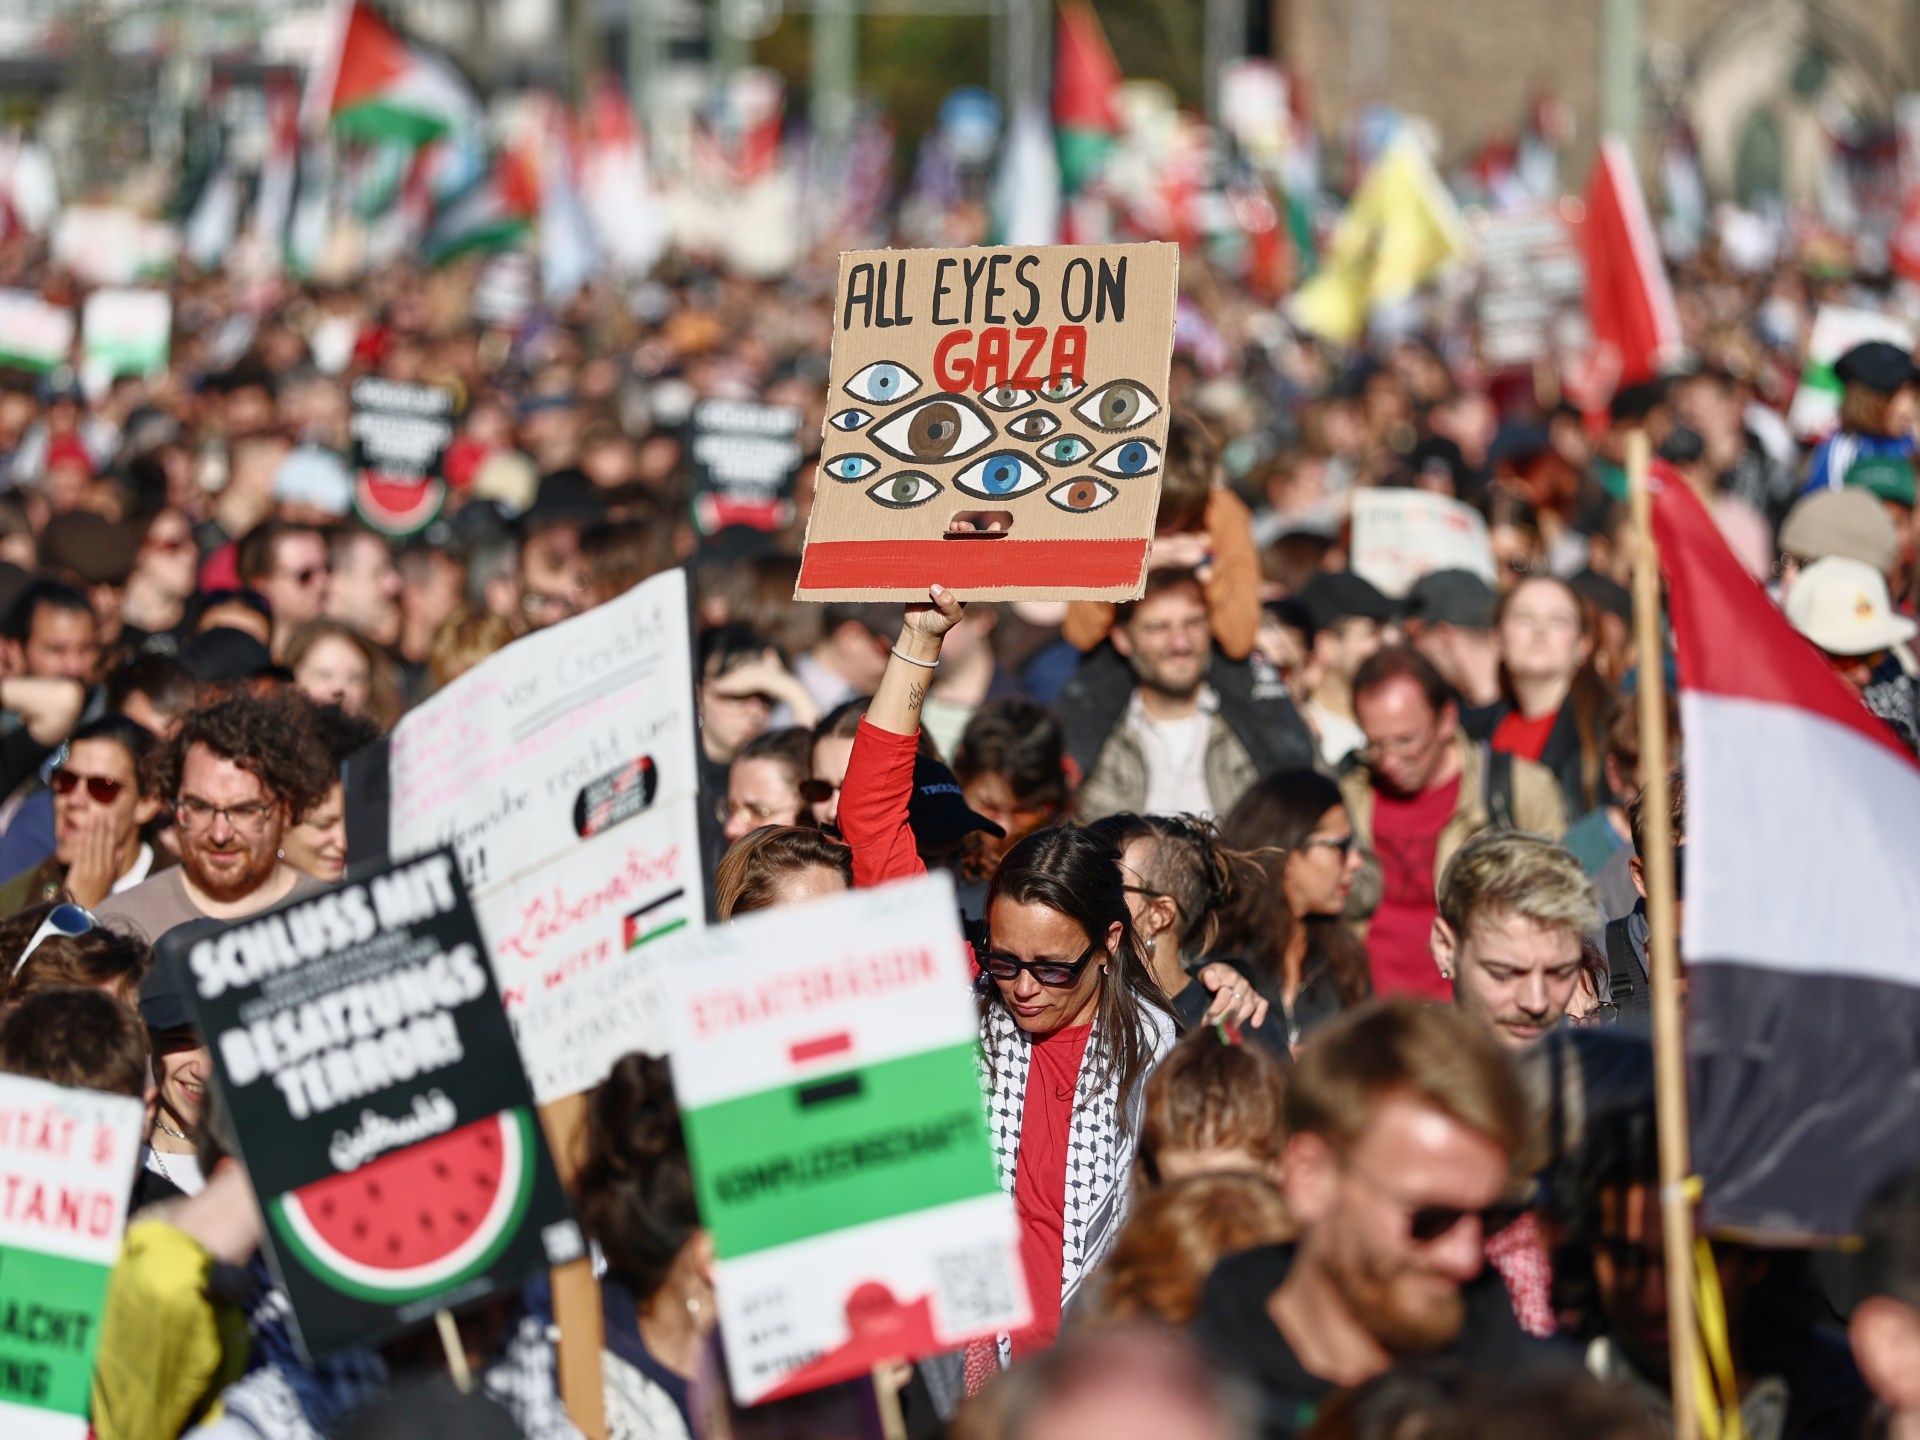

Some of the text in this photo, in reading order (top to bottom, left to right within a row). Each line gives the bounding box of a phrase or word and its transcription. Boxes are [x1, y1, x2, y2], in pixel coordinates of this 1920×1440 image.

[844, 255, 1127, 330] ALL EYES ON
[933, 325, 1087, 393] GAZA
[189, 884, 377, 999] SCHLUSS
[370, 853, 456, 932] MIT
